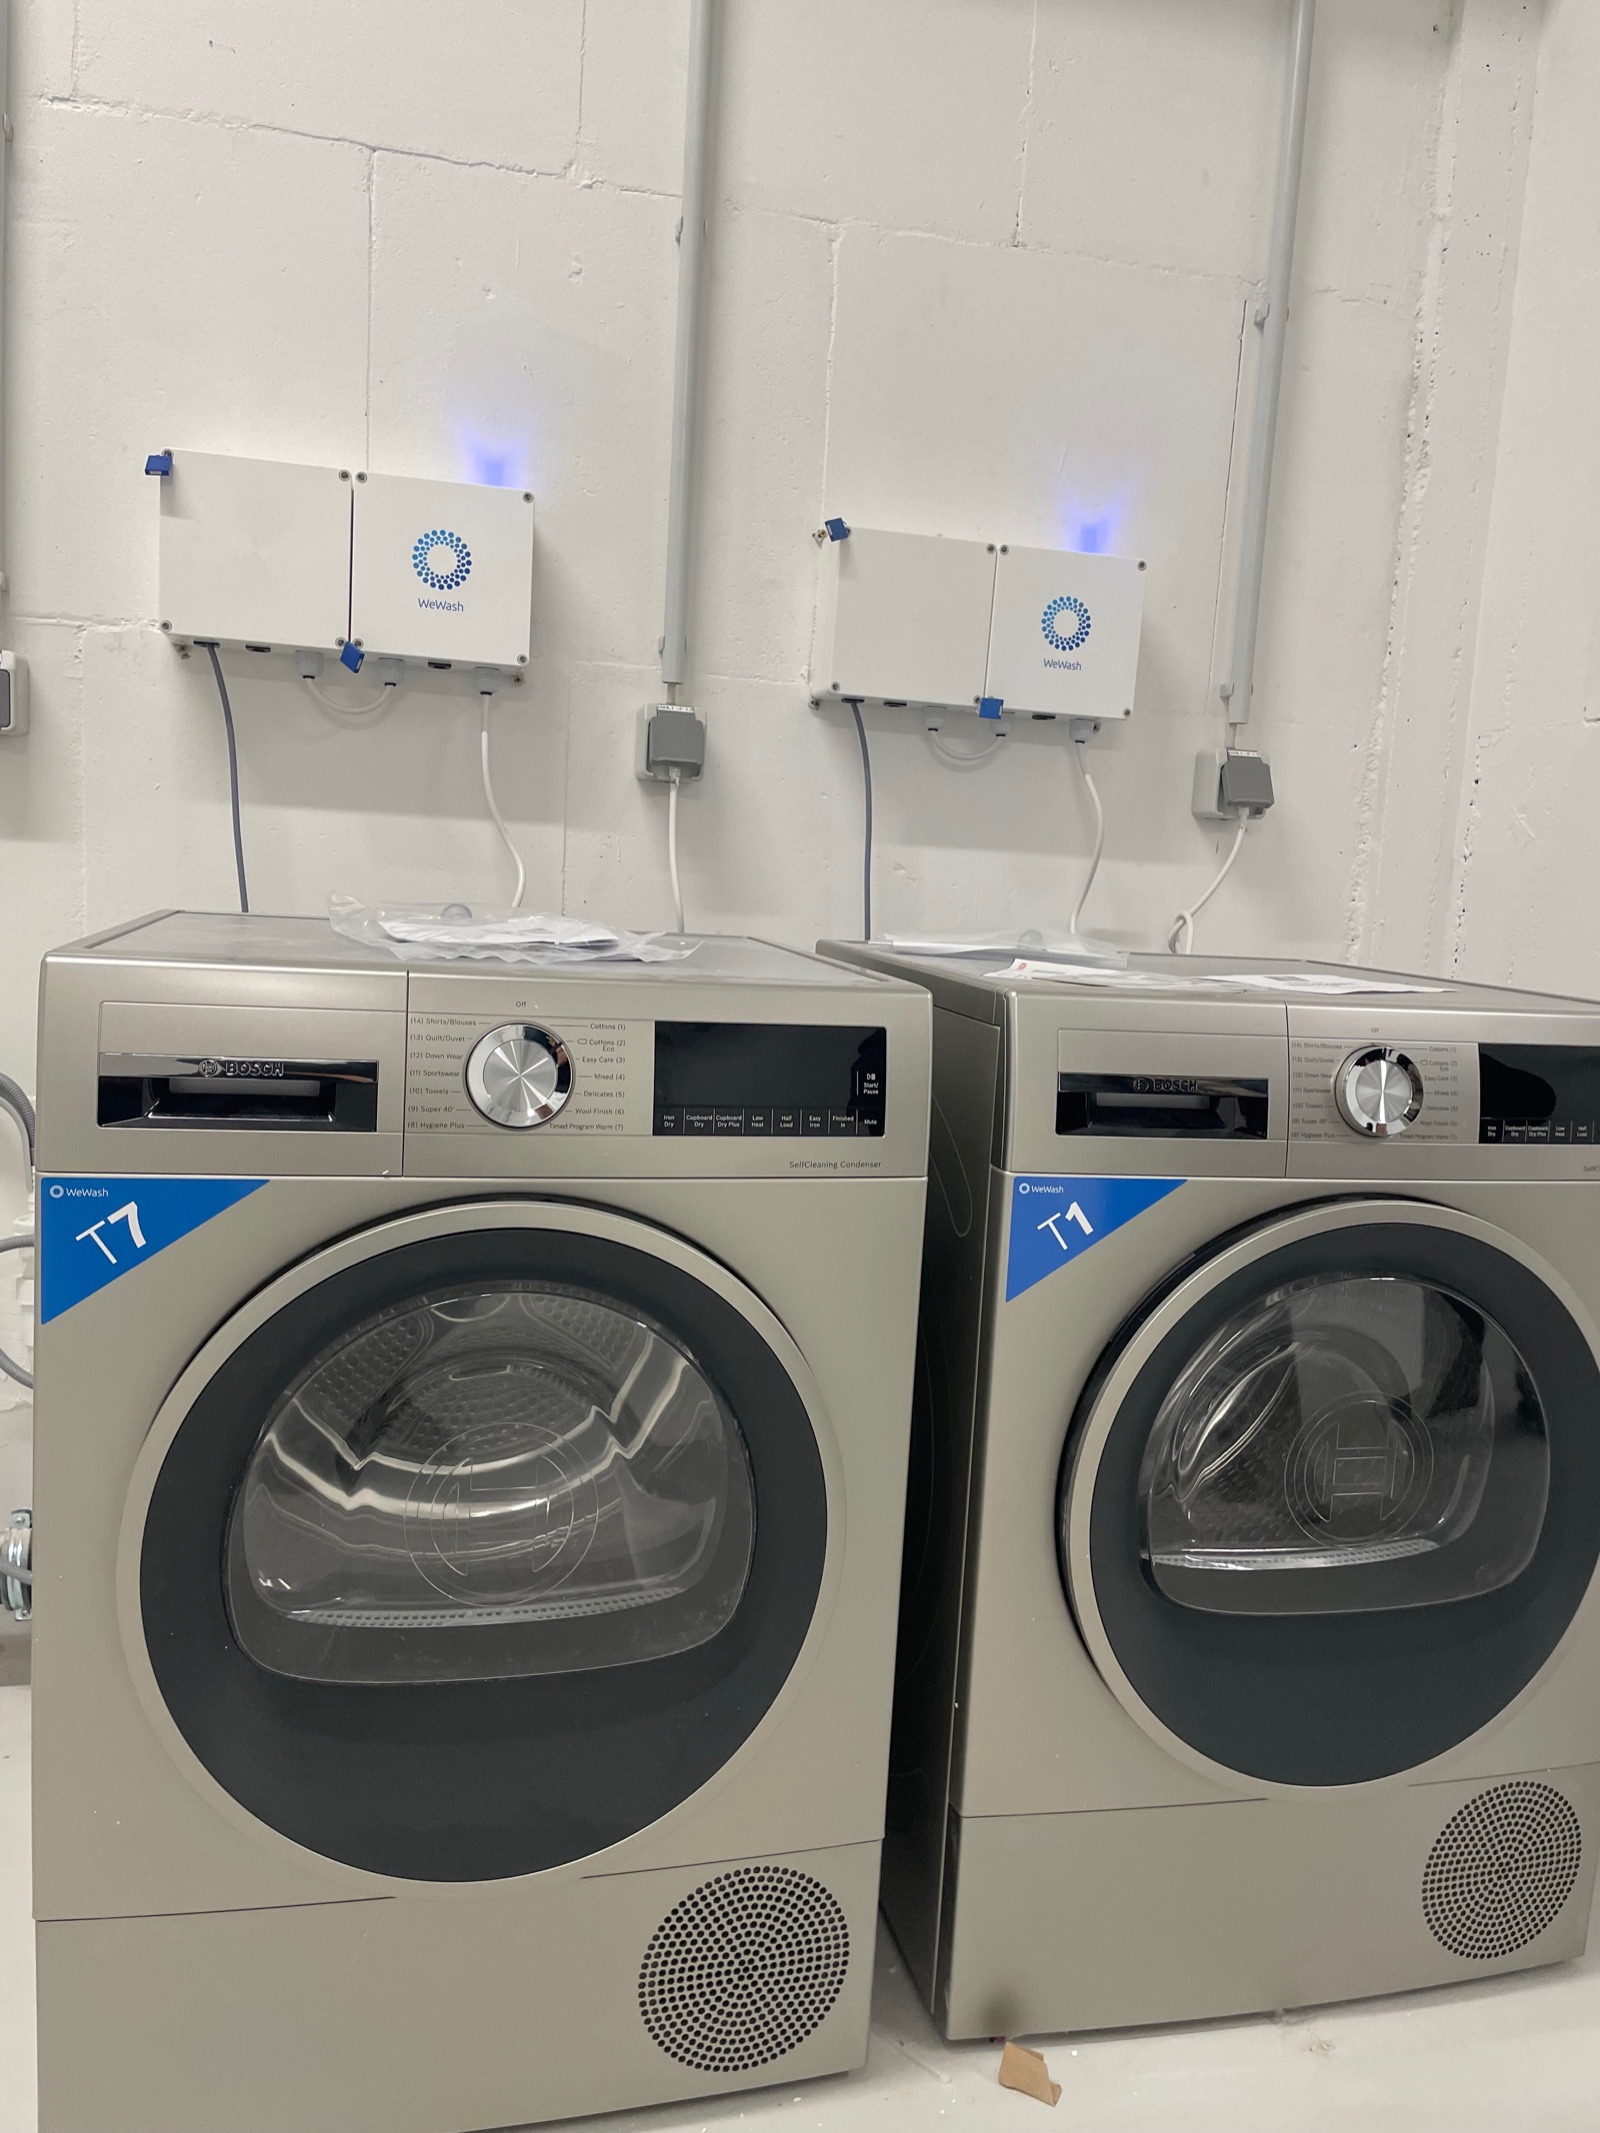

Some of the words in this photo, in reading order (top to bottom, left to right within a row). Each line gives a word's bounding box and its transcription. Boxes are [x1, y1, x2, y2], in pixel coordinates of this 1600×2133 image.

[418, 598, 464, 612] WeWash
[1043, 658, 1082, 671] WeWash
[515, 1000, 526, 1008] Off
[410, 1017, 424, 1025] (14)
[425, 1018, 477, 1026] Shirts/Blouses
[617, 1023, 626, 1031] (1)
[425, 1035, 465, 1043] Quilt/Duvet
[410, 1052, 423, 1060] (12)
[582, 1056, 597, 1064] Easy
[225, 1061, 284, 1077] BOSCH
[409, 1069, 421, 1077] (11)
[423, 1069, 460, 1079] Sportswear
[594, 1073, 614, 1081] Mixed
[615, 1073, 625, 1081] (4)
[1153, 1079, 1198, 1093] BOSCH
[409, 1087, 423, 1095] (10)
[408, 1105, 419, 1113] (9)
[420, 1106, 441, 1114] Super
[614, 1108, 625, 1116] (6)
[407, 1121, 418, 1129] (8)
[420, 1122, 448, 1130] Hygiene
[568, 1123, 595, 1131] Program
[663, 1121, 675, 1129] Dry
[789, 1160, 838, 1170] SelfCleaning
[840, 1161, 882, 1169] Condenser
[65, 1187, 109, 1197] WeWash
[1031, 1185, 1064, 1194] WeWash
[1036, 1201, 1094, 1251] T1
[75, 1200, 147, 1265] T7
